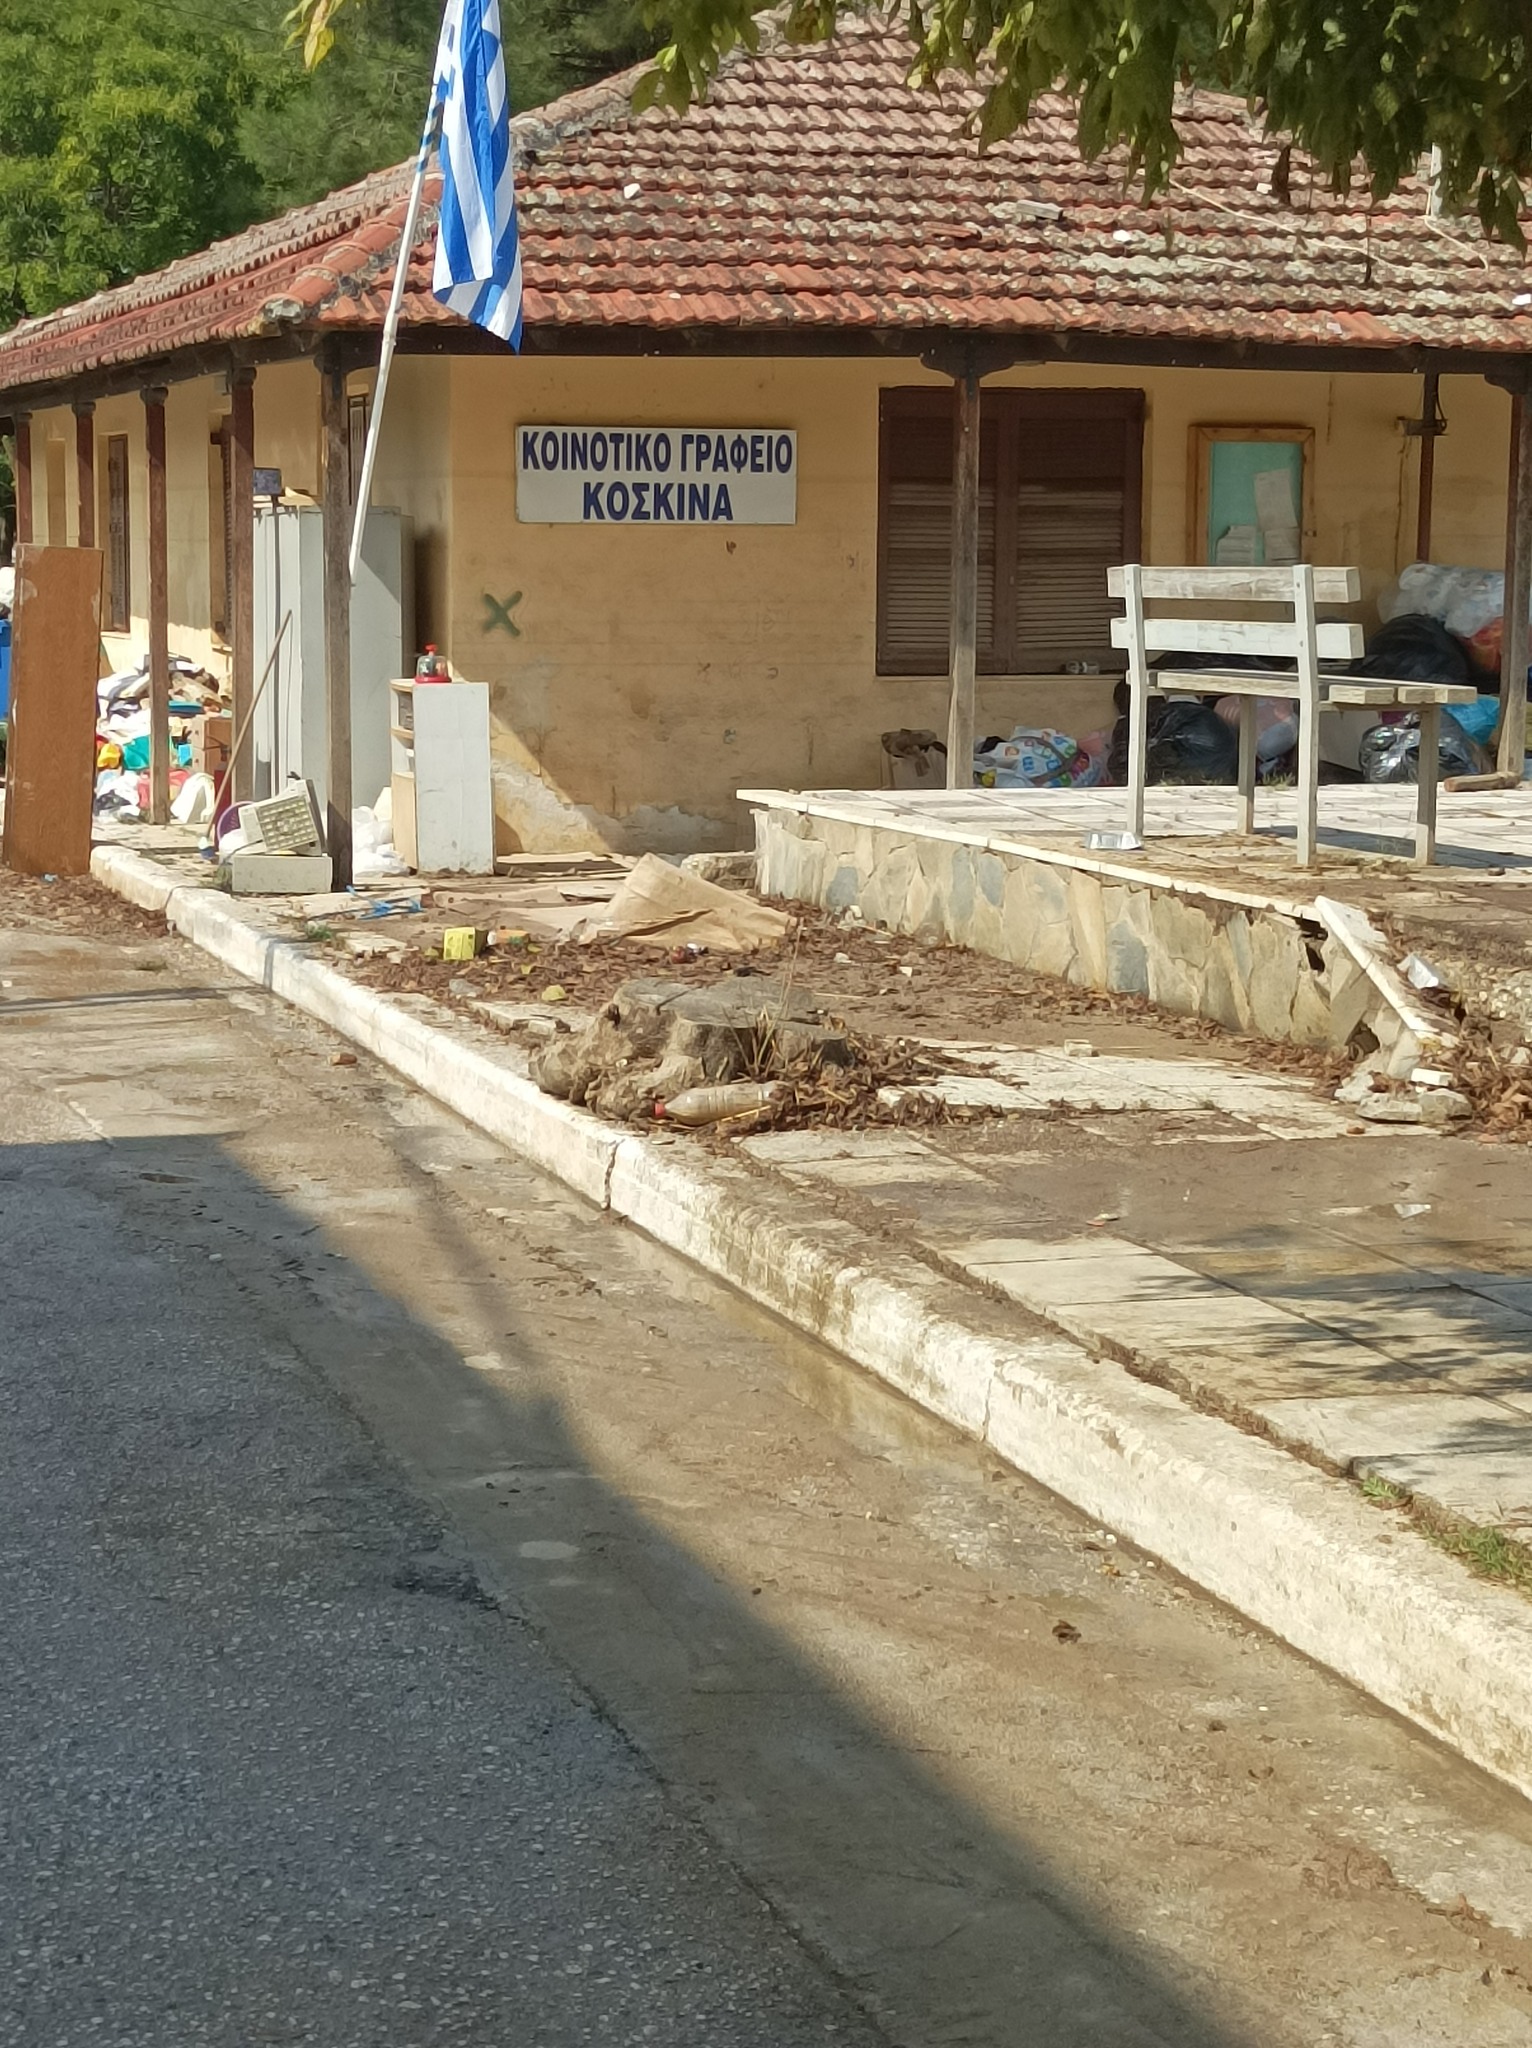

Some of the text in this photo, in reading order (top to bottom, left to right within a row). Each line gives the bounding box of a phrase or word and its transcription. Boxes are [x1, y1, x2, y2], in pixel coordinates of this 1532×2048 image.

[522, 431, 792, 473] ΚΟΙΝΟΤΙΚΟ ΓΡΑΦΕΙΟ
[583, 482, 733, 521] ΚΟΣΚΙΝΑ
